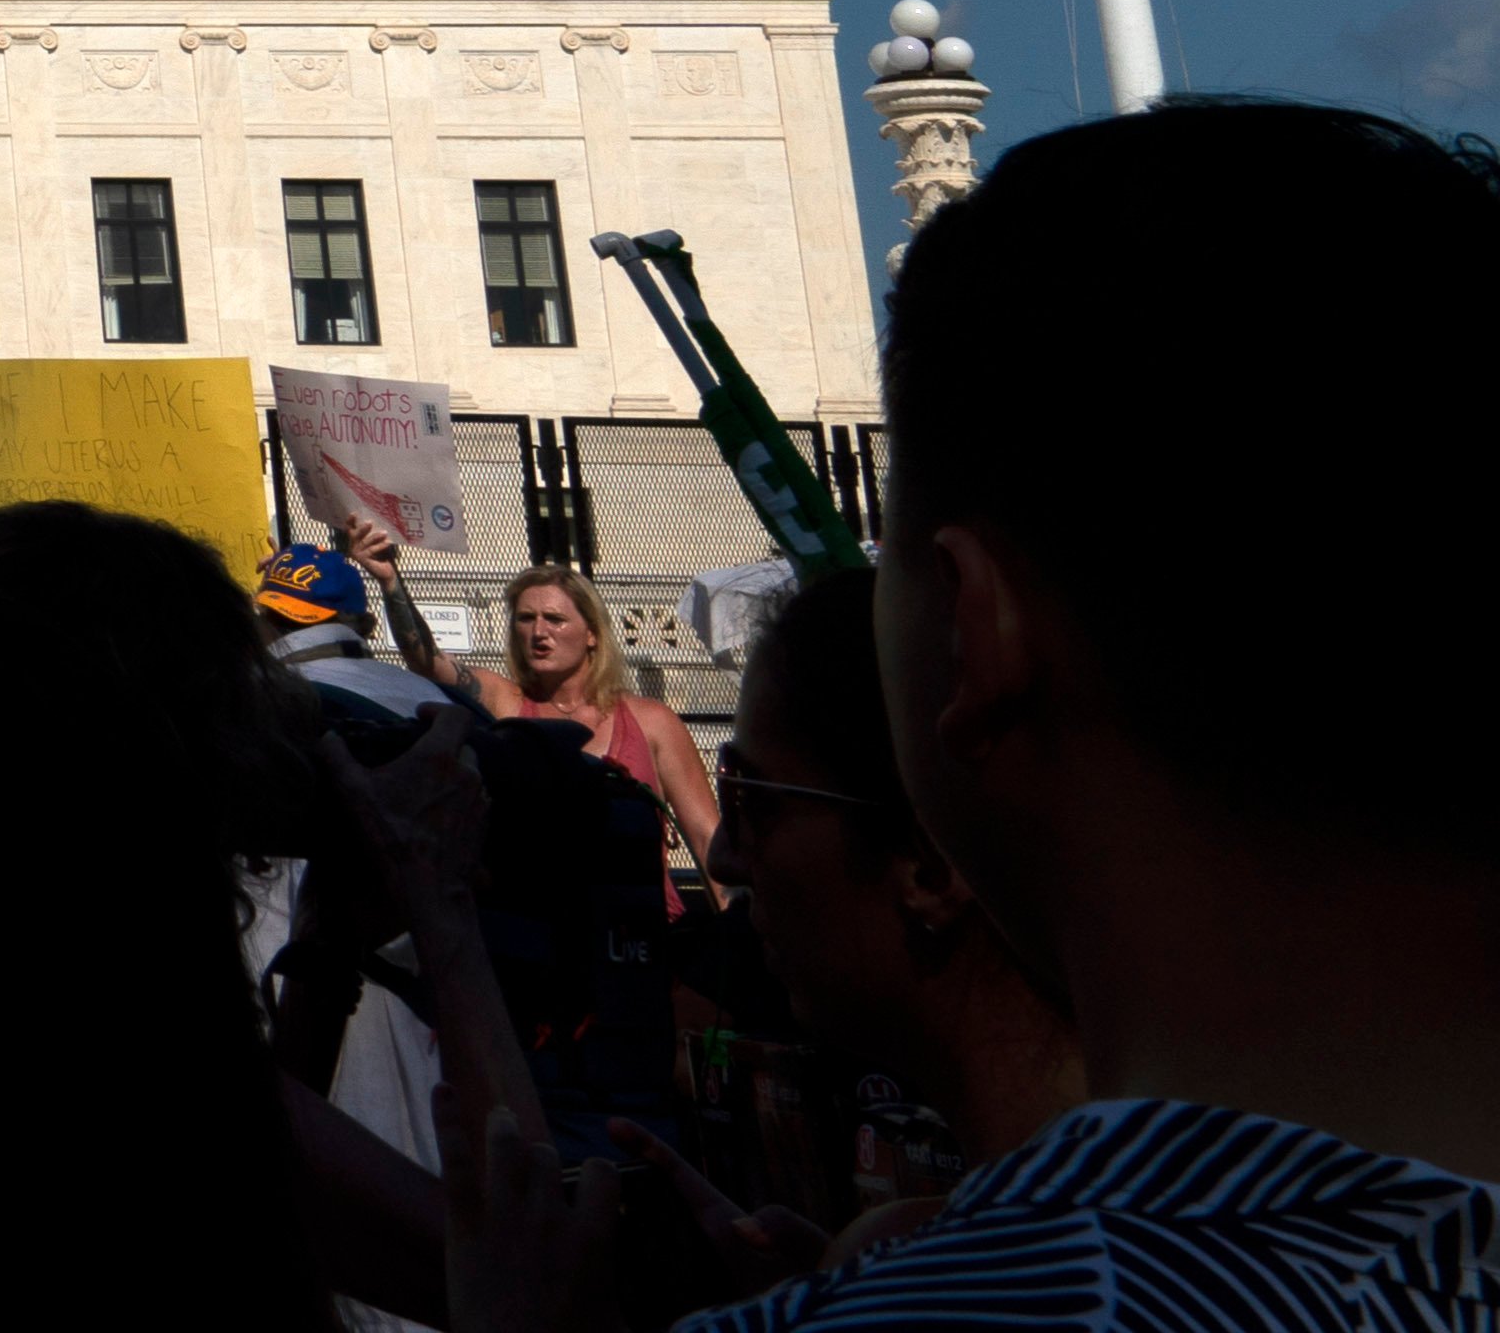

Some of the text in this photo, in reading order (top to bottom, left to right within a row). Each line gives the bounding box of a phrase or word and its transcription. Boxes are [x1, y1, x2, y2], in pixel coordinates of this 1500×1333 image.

[99, 370, 212, 433] MAKE
[273, 372, 413, 415] Even robots
[43, 437, 143, 475] UTERUS
[422, 609, 460, 622] CLOSED
